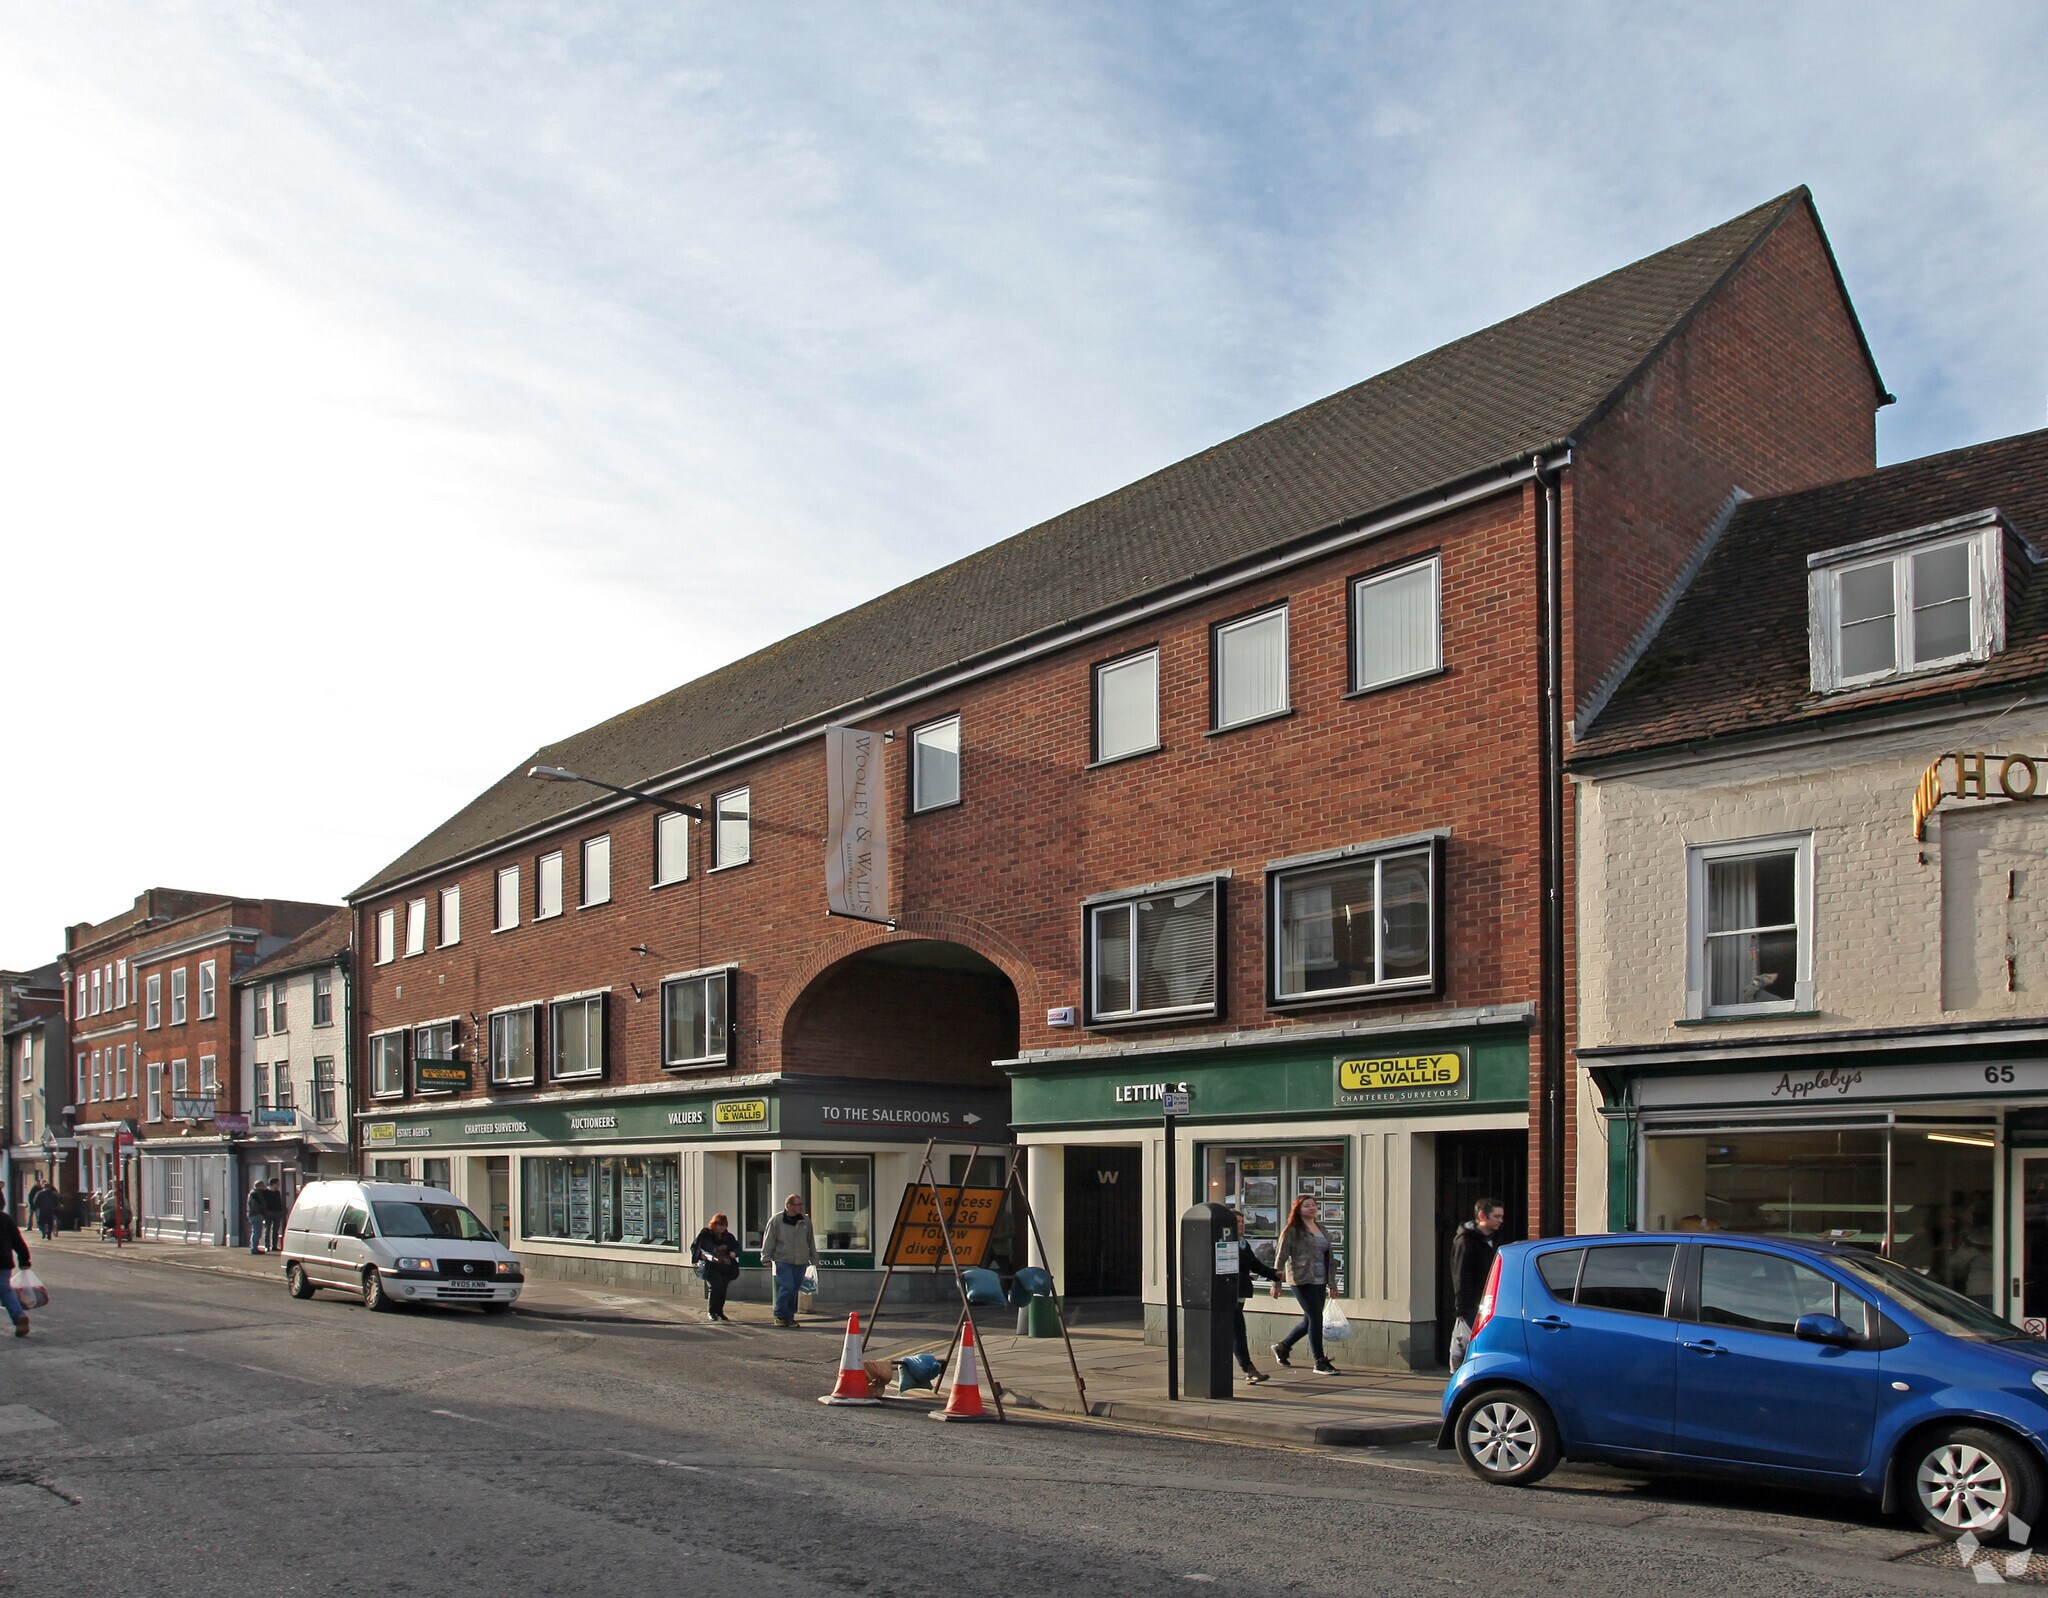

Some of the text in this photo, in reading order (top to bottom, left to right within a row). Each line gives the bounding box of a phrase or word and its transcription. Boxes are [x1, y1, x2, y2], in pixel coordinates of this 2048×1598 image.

[855, 736, 872, 914] WOOLLEY & WALLIS
[1349, 1056, 1442, 1075] WOOLLEY
[1360, 1069, 1451, 1086] & WALLIS
[1984, 1065, 2016, 1084] 65
[1115, 1081, 1188, 1102] LETTINS
[1341, 1089, 1459, 1102] CHARTERED SURVEYORS
[719, 1103, 757, 1112] WOOLLEY
[667, 1111, 703, 1125] VALUERS
[723, 1110, 761, 1120] & WALLIS
[822, 1106, 950, 1124] TO THE SALEROOMS
[464, 1121, 527, 1134] CHARTERED SURVEYORS
[570, 1116, 615, 1129] AUCTIONEERS
[396, 1127, 431, 1138] ESTATE AGENTS
[1222, 1227, 1231, 1241] P
